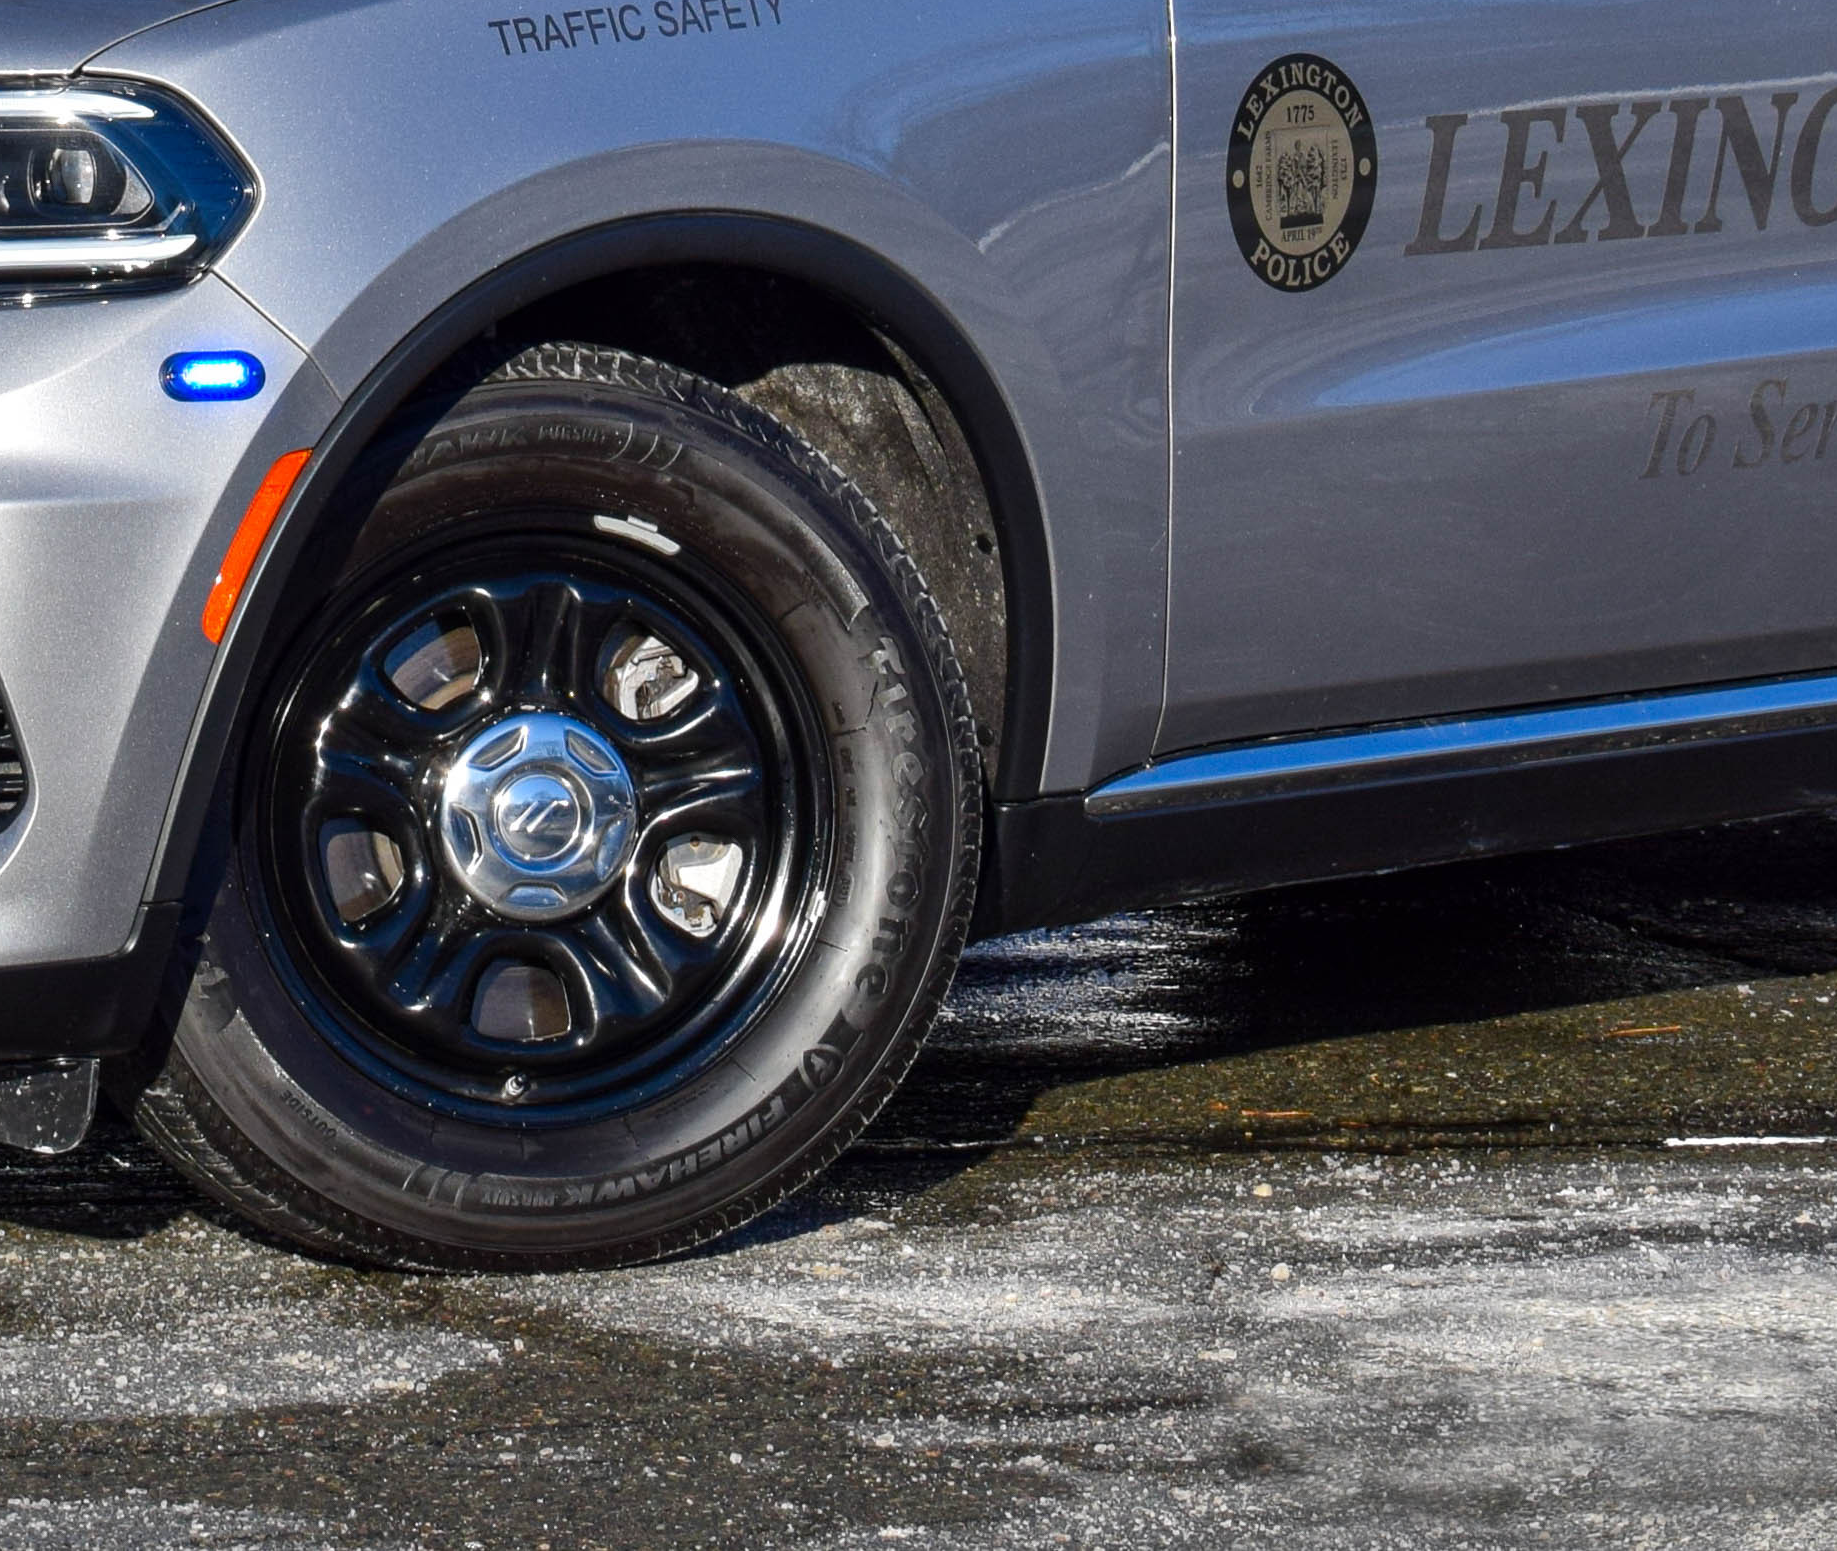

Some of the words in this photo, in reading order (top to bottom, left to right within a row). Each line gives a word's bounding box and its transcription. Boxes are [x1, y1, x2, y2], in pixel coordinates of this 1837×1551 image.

[488, 3, 646, 55] TRAFFIC
[1237, 62, 1362, 141] LEXINGTON
[1286, 105, 1315, 124] 1775
[1250, 232, 1350, 286] POLICE
[1281, 228, 1306, 242] APRIL
[1639, 388, 1716, 481] To
[854, 636, 928, 996] Firestone
[279, 1089, 338, 1140] OUTSIDE
[566, 1095, 788, 1206] FIREHAWK
[480, 1186, 556, 1207] PURSUIT
